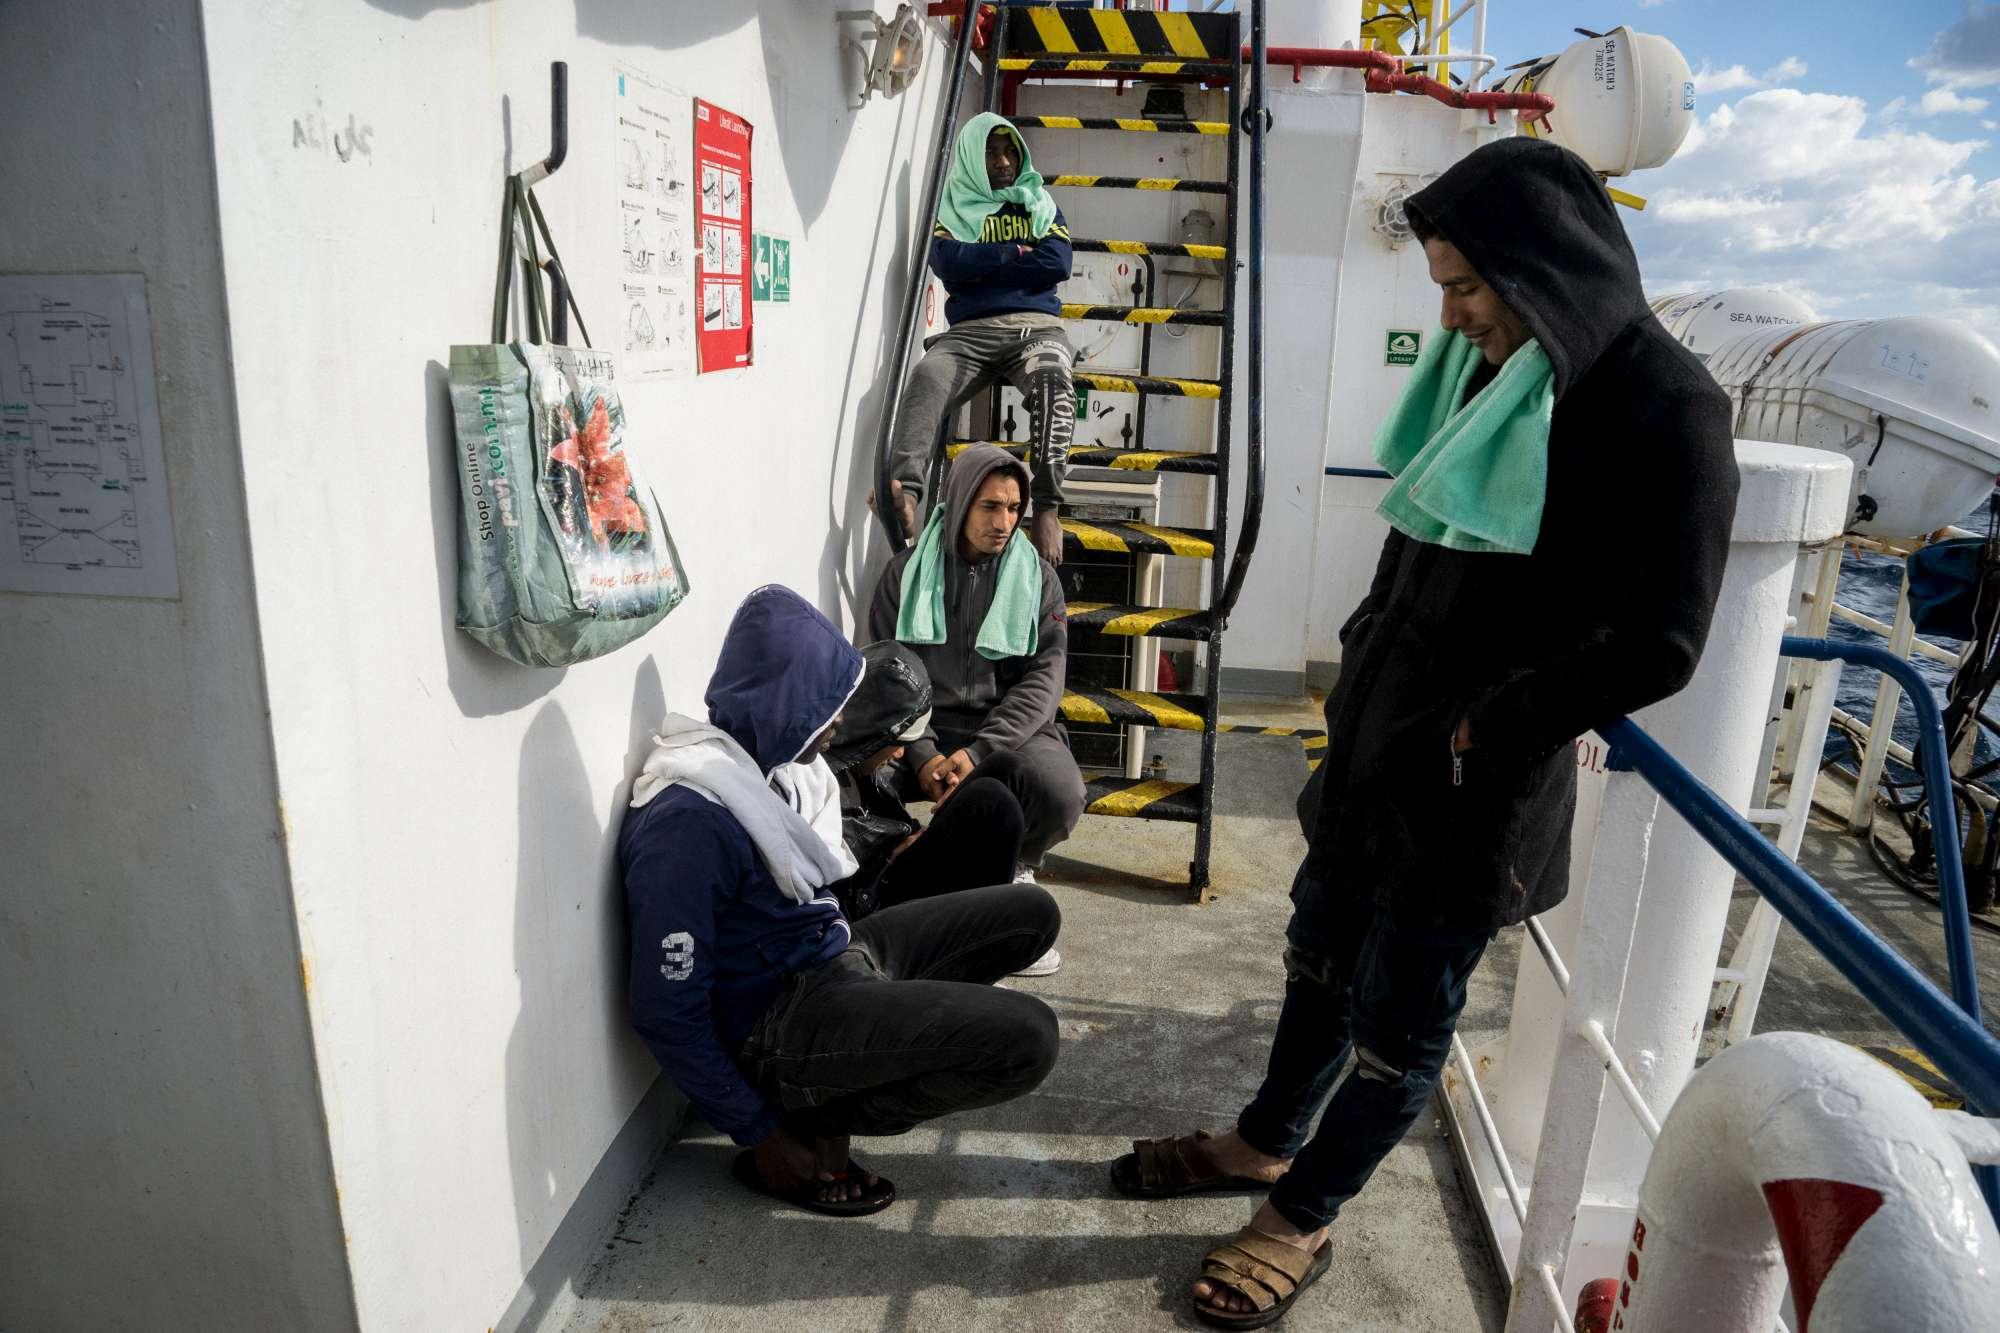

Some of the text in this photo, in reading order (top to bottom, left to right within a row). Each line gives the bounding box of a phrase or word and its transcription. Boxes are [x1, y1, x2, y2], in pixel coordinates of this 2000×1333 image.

[1730, 312, 1753, 323] SEA
[466, 442, 495, 541] Shop Online
[660, 931, 695, 981] 3
